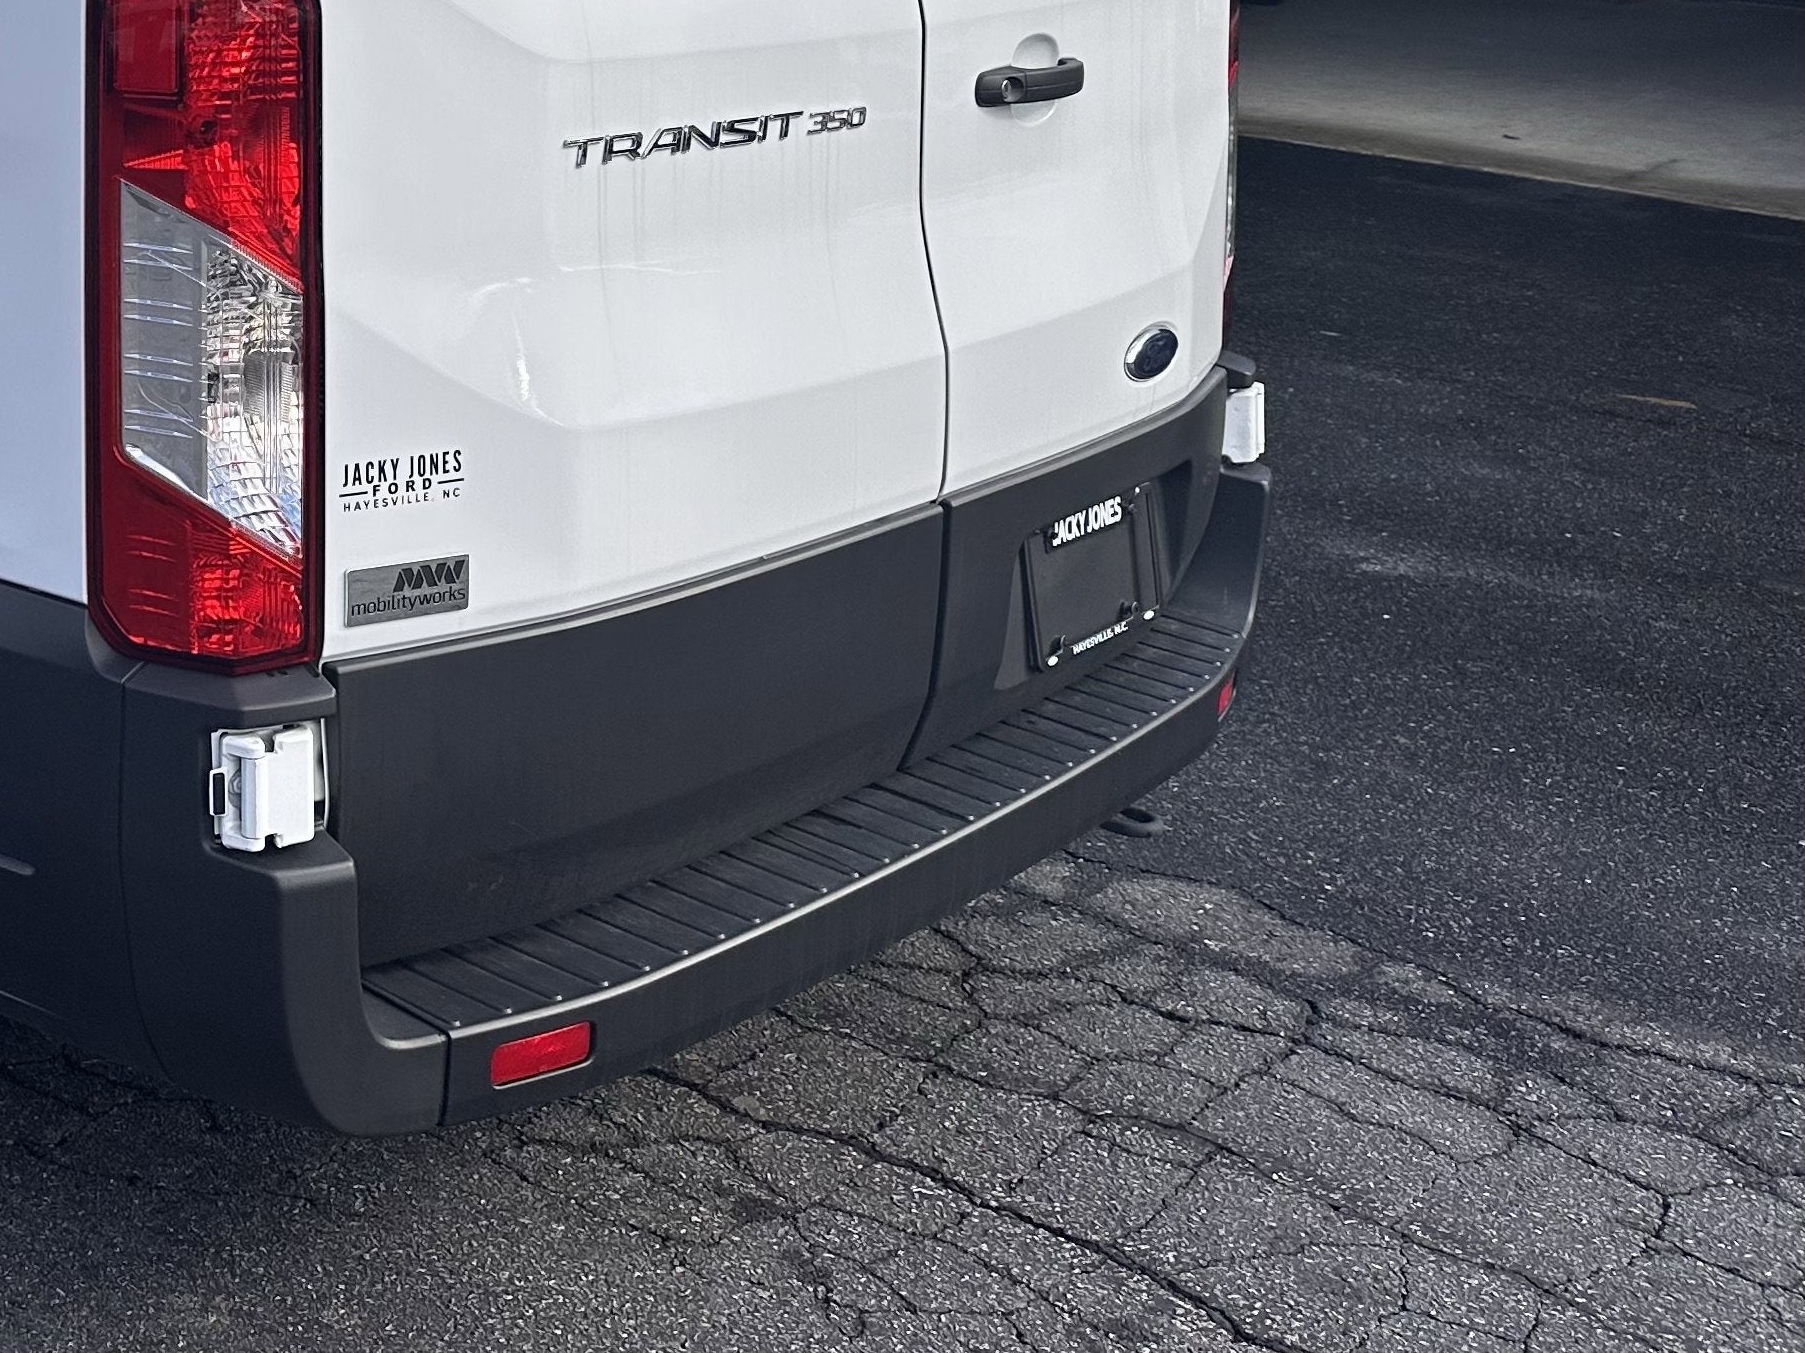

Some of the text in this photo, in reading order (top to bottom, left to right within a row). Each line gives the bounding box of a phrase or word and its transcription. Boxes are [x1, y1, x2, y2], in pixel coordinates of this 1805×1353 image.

[562, 106, 867, 168] TRANSIT 350
[343, 449, 462, 487] JACKY JONES
[372, 478, 432, 497] FORD
[442, 487, 461, 499] NC
[1052, 496, 1122, 547] JACKY JONES
[350, 586, 466, 617] mobilityworks
